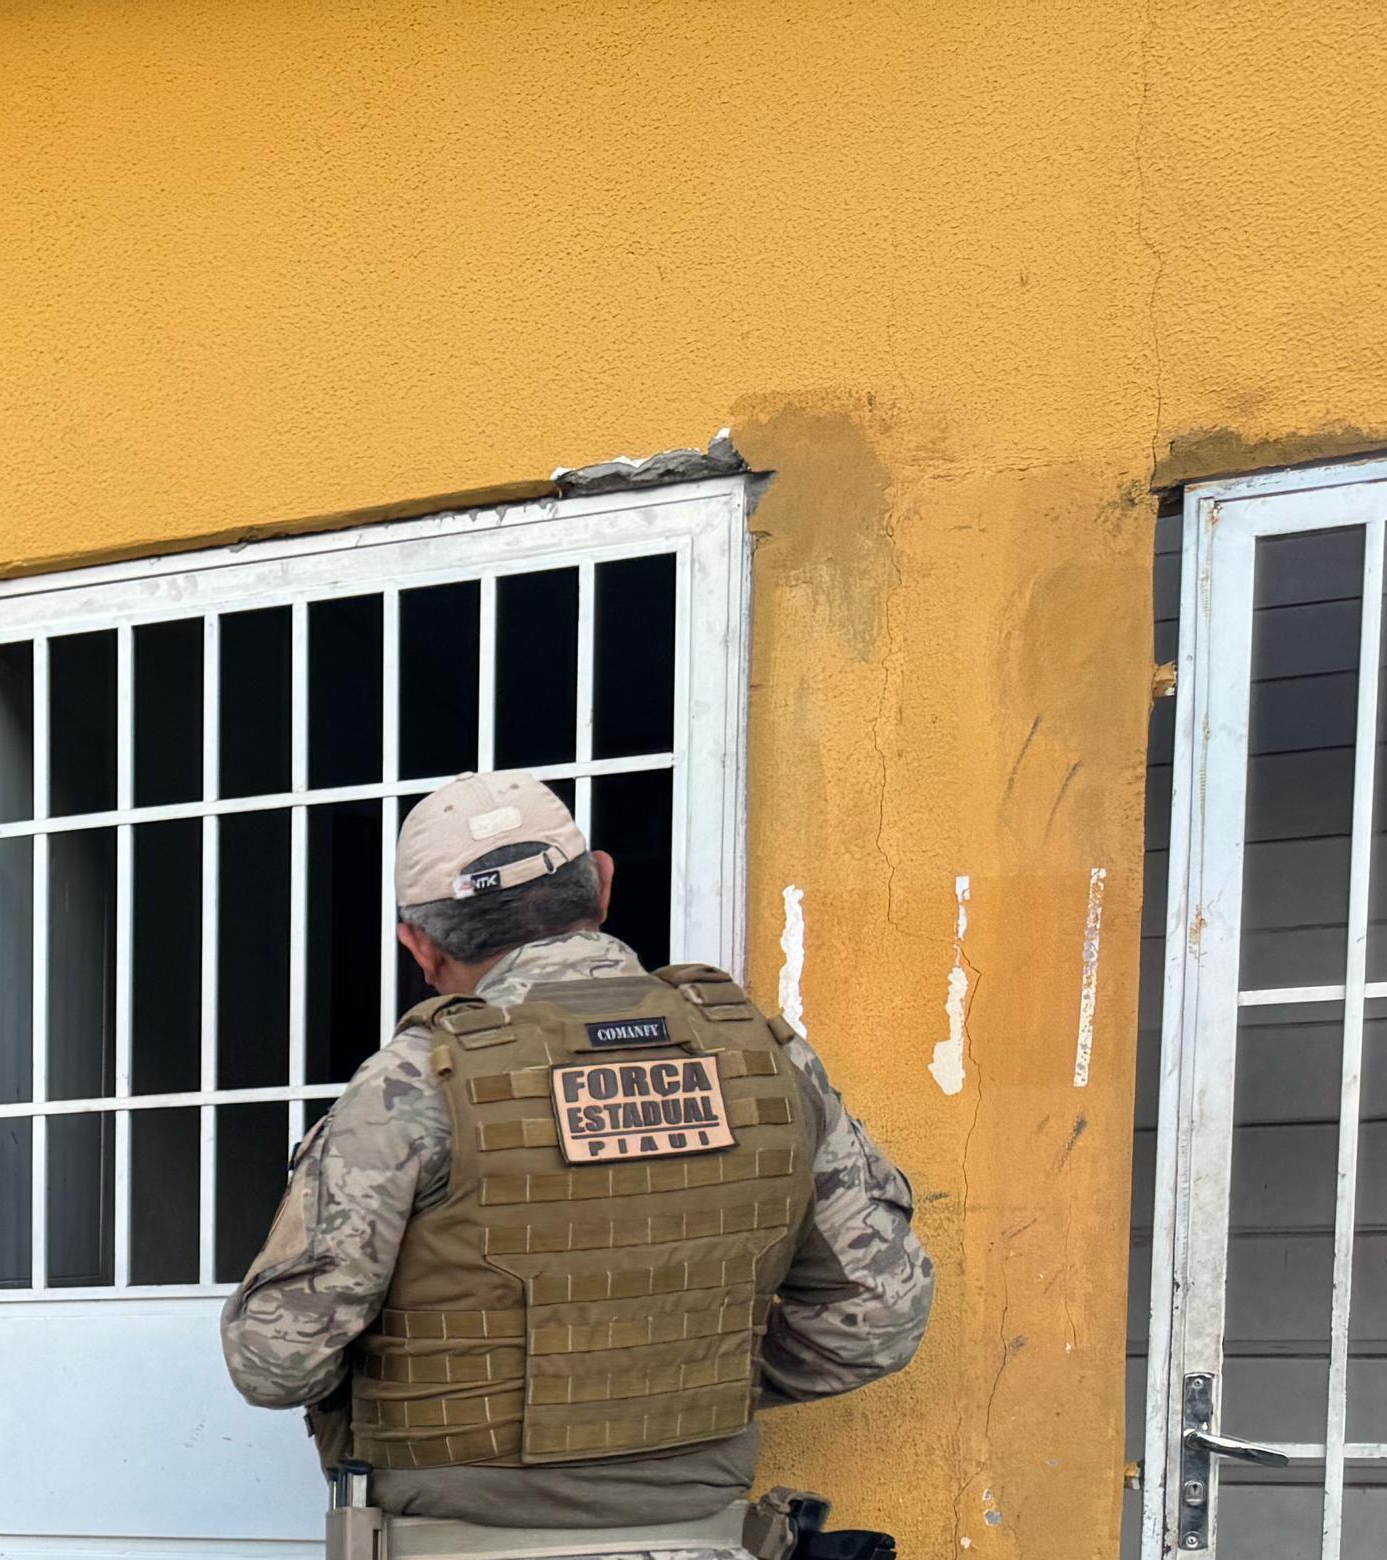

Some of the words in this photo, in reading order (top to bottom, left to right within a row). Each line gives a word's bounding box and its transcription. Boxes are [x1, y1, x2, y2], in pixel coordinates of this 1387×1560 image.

[562, 1062, 713, 1103] FORÇA
[567, 1096, 719, 1133] ESTADUAL
[588, 1130, 710, 1157] PIAUI
